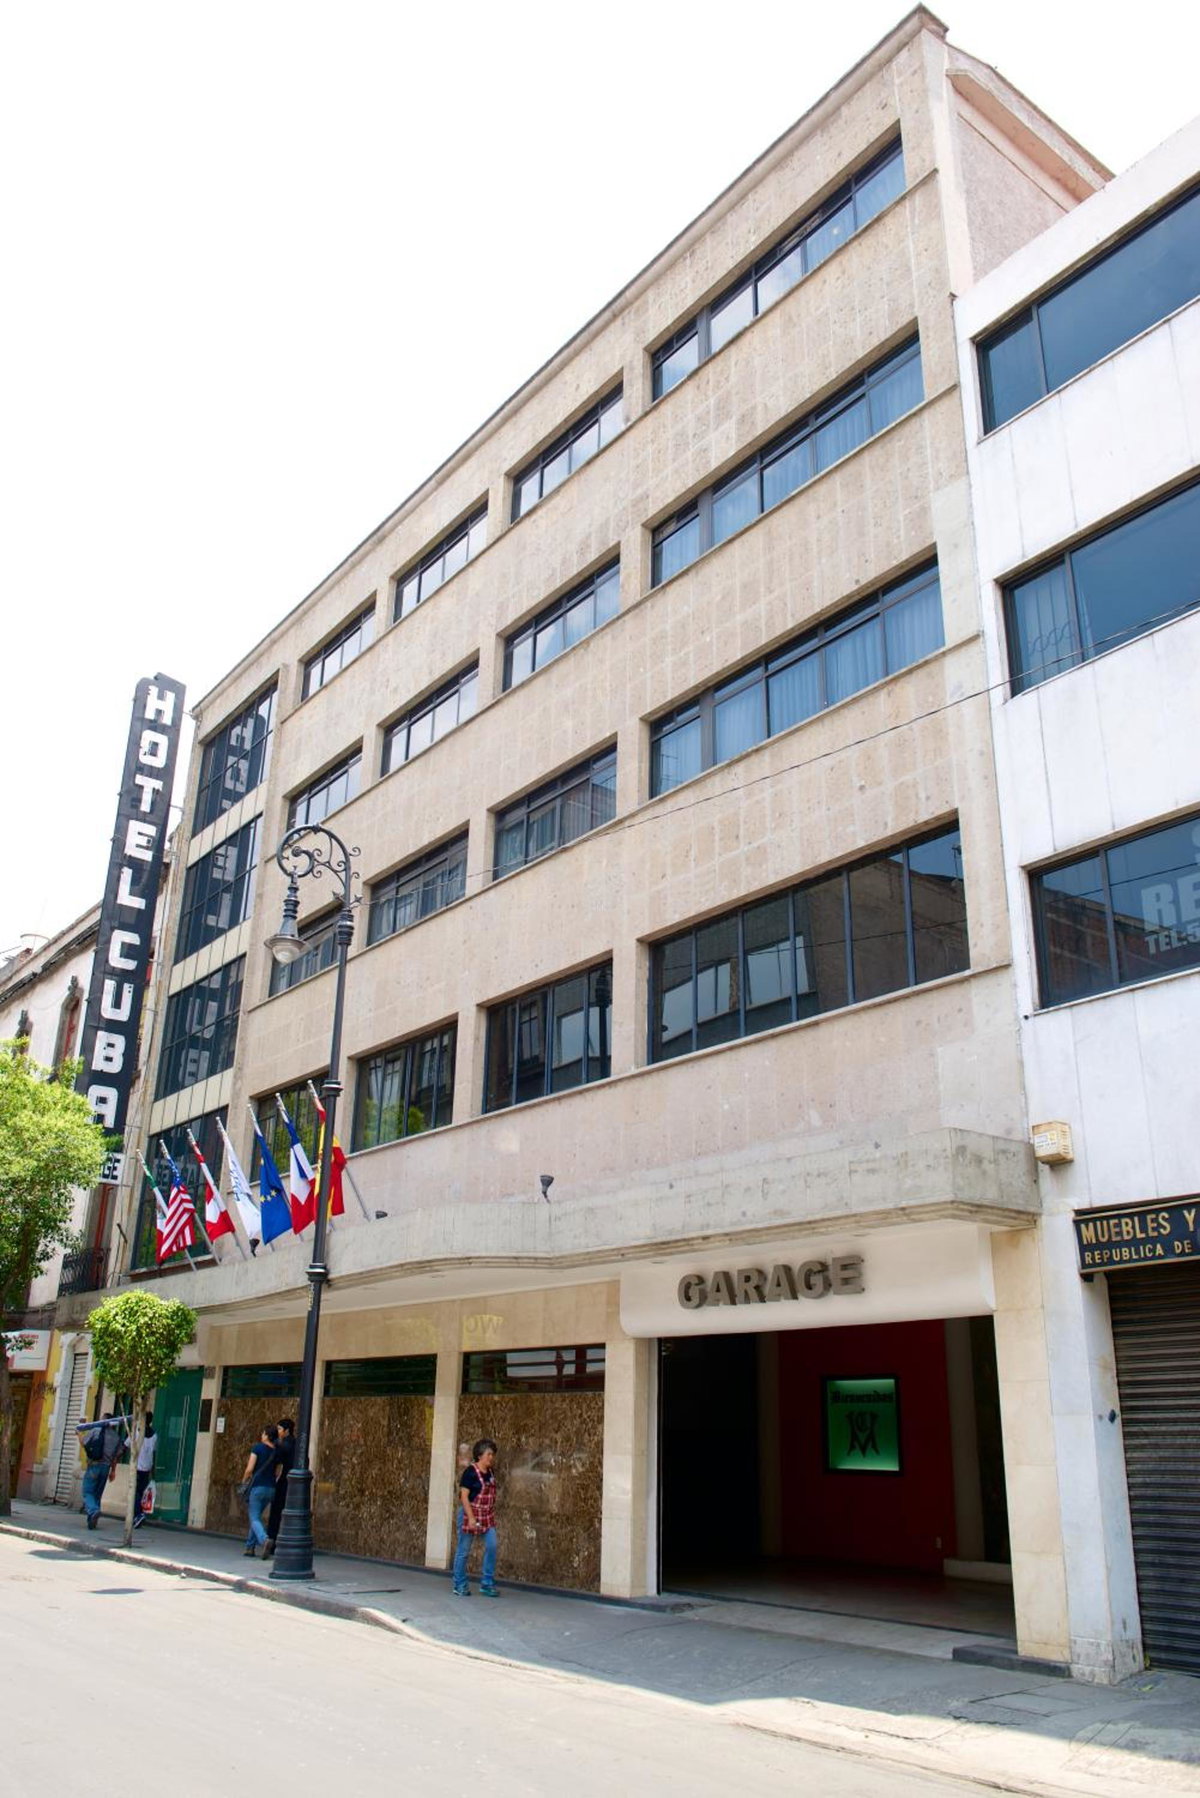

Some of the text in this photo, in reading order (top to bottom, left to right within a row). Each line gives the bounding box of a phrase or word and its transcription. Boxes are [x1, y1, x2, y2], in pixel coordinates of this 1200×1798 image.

[87, 686, 175, 1128] HOTEL CUBA
[1081, 1208, 1196, 1245] MUEBLES Y
[1085, 1240, 1192, 1264] REPUBLICA DE
[677, 1255, 865, 1309] GARAGE
